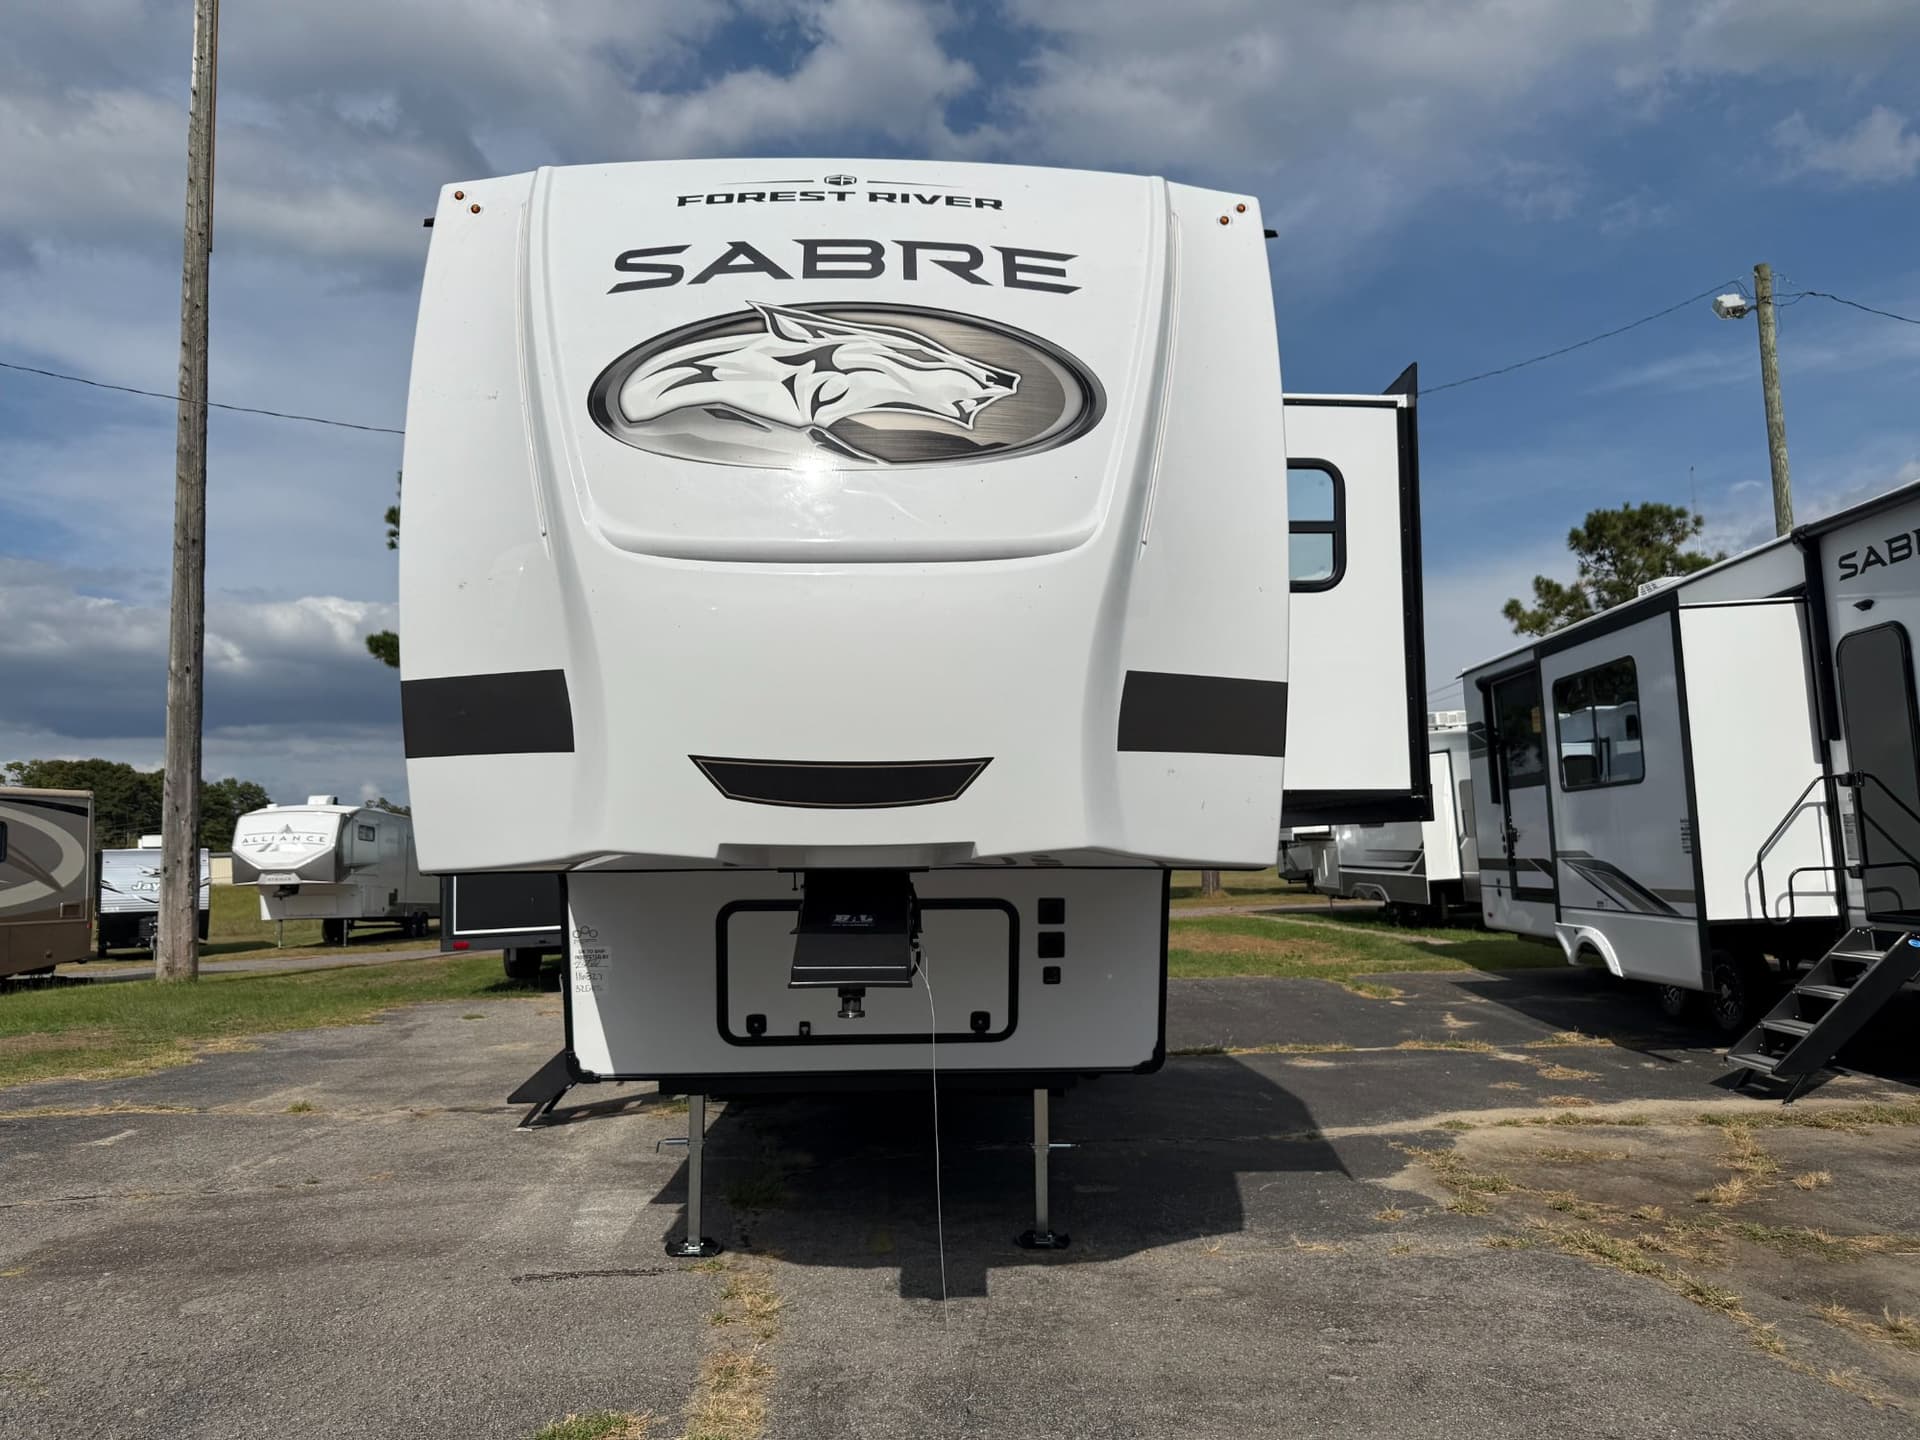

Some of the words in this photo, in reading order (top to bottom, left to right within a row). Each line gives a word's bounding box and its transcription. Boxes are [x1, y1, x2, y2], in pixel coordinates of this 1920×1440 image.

[676, 191, 857, 207] FOREST
[868, 191, 1004, 210] RIVER
[607, 239, 1082, 295] SABRE
[241, 834, 327, 844] ALLIANCE
